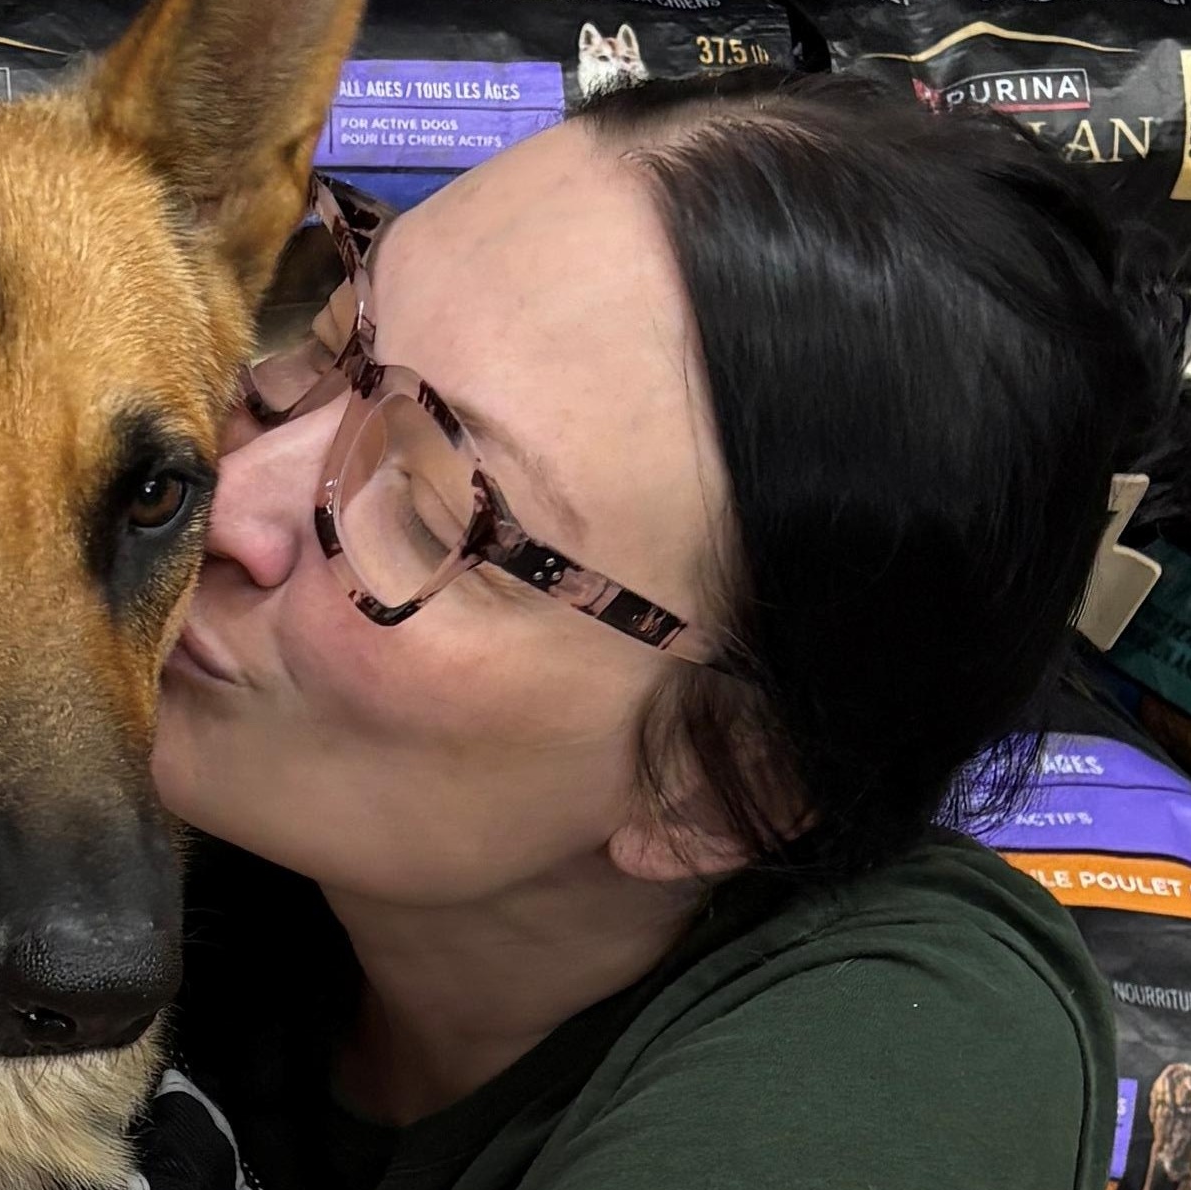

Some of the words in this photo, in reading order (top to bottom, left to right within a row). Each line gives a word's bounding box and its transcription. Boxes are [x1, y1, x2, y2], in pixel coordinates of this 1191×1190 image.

[695, 35, 748, 65] 37.5
[339, 80, 363, 97] ALL
[366, 80, 402, 98] AGES
[405, 81, 412, 98] /
[414, 81, 452, 99] TOUS
[455, 82, 481, 100] LES
[946, 74, 1080, 113] PURINA
[340, 117, 368, 130] FOR
[372, 118, 417, 131] ACTIVE
[421, 119, 458, 131] DOGS
[340, 133, 378, 146] POUR
[381, 134, 405, 147] LES
[409, 134, 455, 148] CHIENS
[458, 136, 502, 149] ACTIFS
[1015, 811, 1093, 827] ACTIFS
[1029, 867, 1073, 889] LE
[1079, 870, 1182, 898] POULET
[1112, 981, 1191, 1012] NOURRITU
